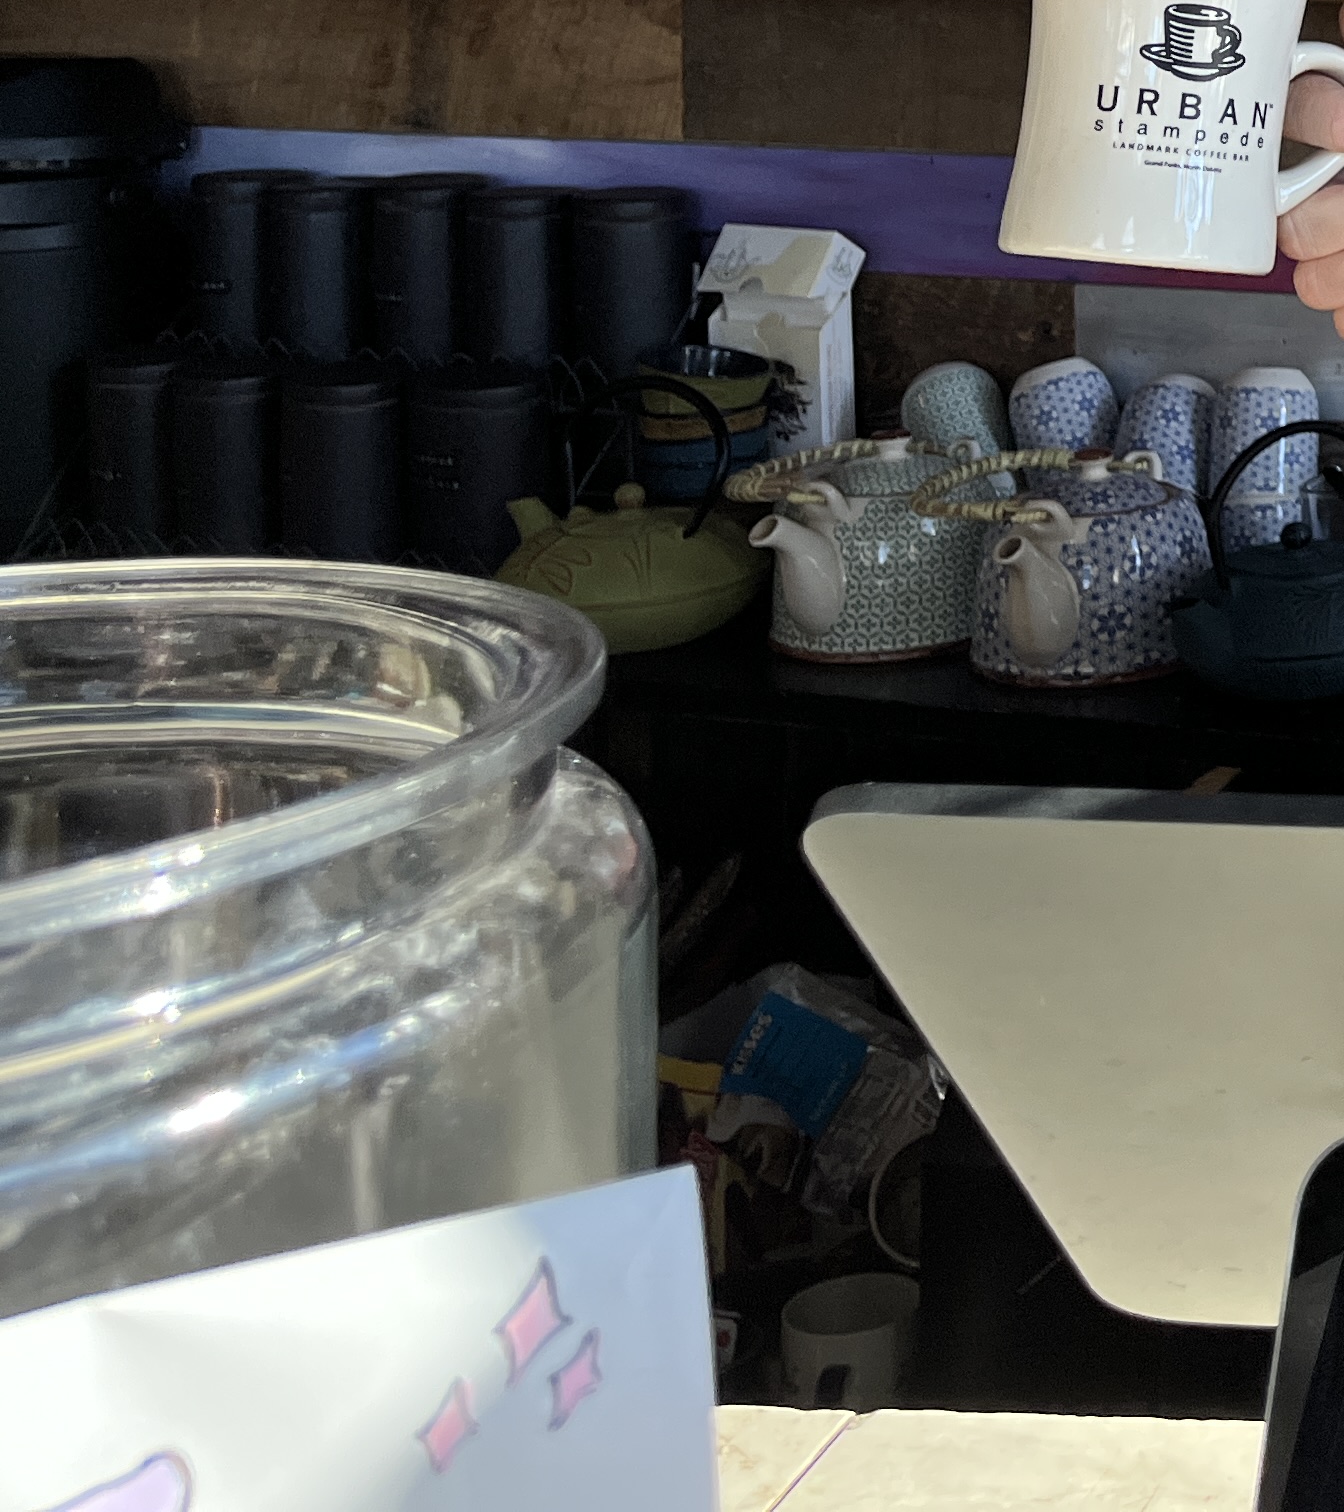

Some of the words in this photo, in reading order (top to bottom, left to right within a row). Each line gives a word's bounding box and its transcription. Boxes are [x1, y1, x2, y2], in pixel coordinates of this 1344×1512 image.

[1096, 84, 1268, 130] URBAN
[1093, 118, 1265, 149] stampede
[1112, 141, 1179, 155] LANDMARK
[1185, 148, 1228, 161] COFFEE
[1232, 153, 1249, 163] BAR
